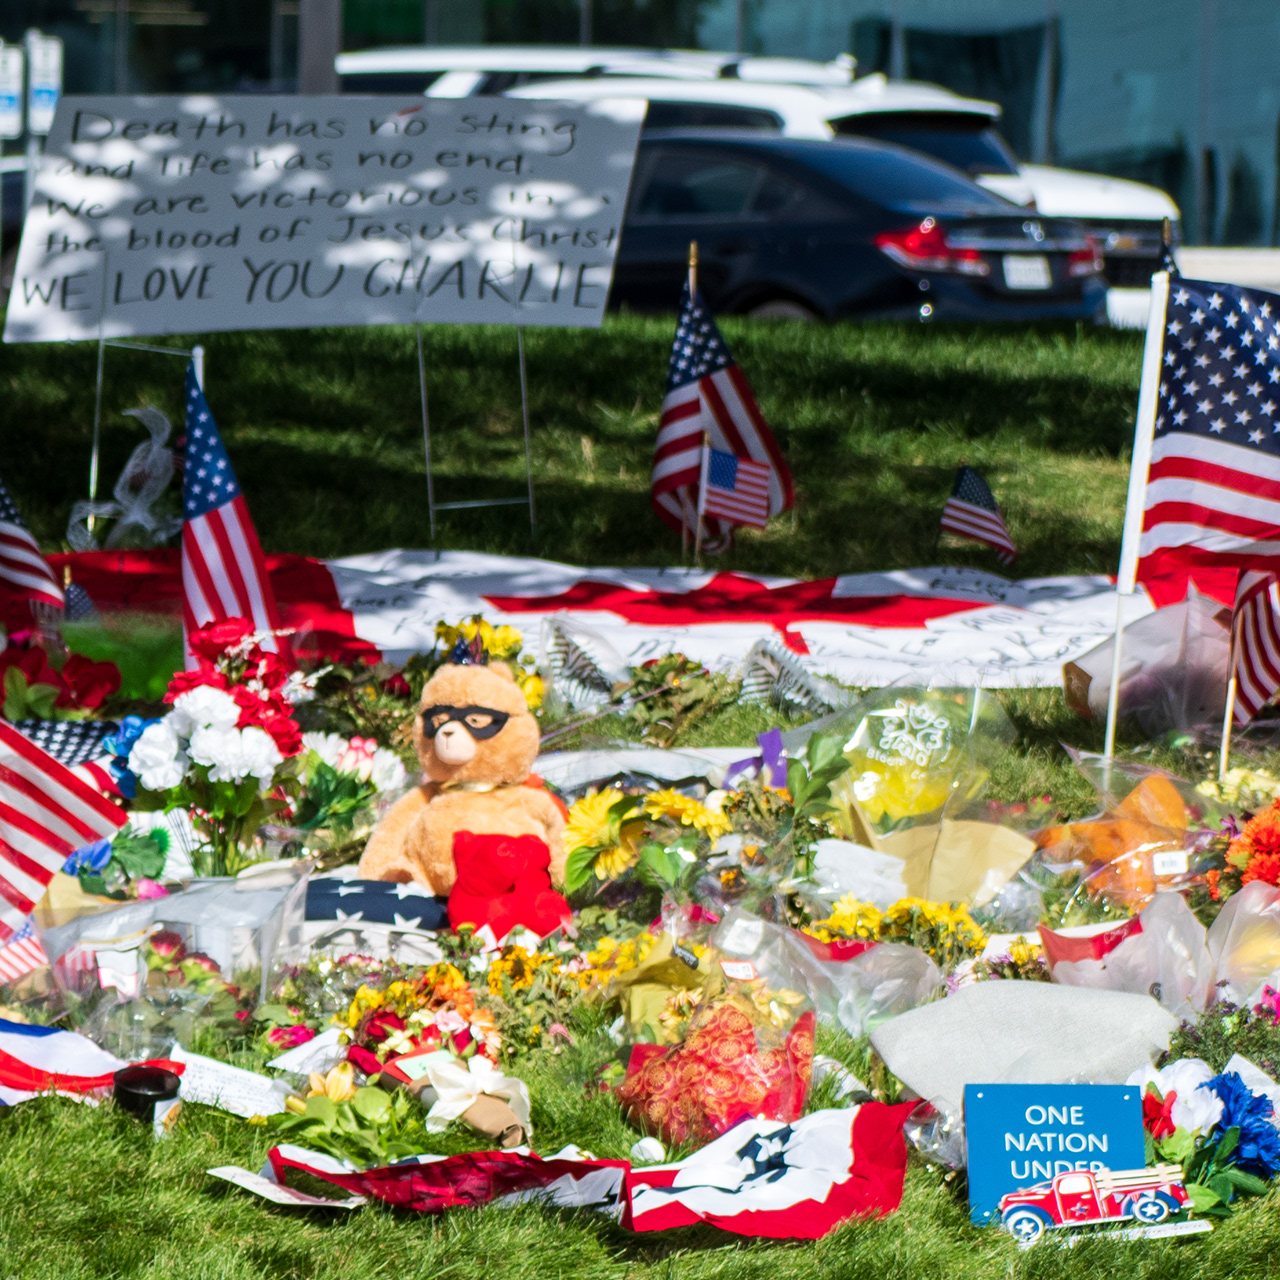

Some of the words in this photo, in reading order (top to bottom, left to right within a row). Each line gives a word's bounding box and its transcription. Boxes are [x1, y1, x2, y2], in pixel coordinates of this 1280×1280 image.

[71, 109, 246, 144] Death
[267, 110, 346, 139] has
[368, 116, 427, 138] no
[55, 159, 135, 180] and
[161, 152, 232, 177] life
[252, 150, 332, 171] has
[357, 151, 413, 169] no
[133, 195, 210, 216] are
[232, 187, 480, 210] victorious
[41, 232, 102, 253] the
[127, 225, 240, 250] blood
[257, 216, 311, 243] of
[327, 215, 470, 244] Jesus
[491, 216, 618, 249] Christ
[21, 270, 92, 312] WE
[112, 262, 217, 306] LOVE
[242, 256, 345, 305] YOU
[362, 255, 608, 310] CHARLIE
[1024, 1105, 1085, 1126] ONE
[1004, 1132, 1109, 1153] NATION
